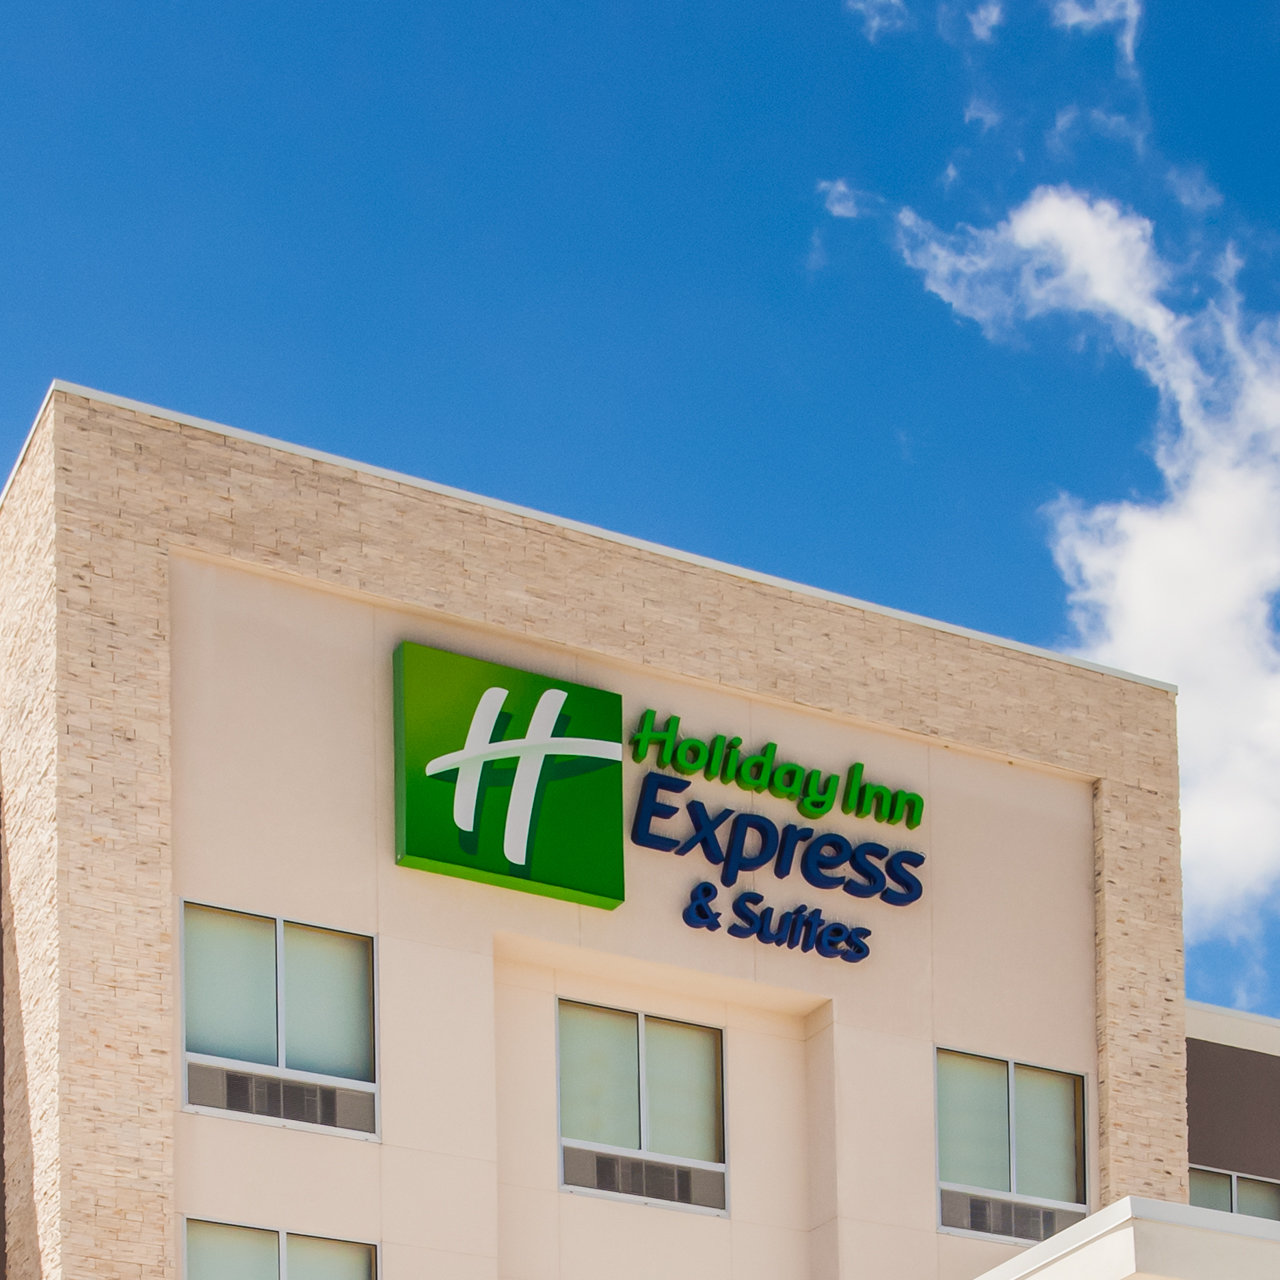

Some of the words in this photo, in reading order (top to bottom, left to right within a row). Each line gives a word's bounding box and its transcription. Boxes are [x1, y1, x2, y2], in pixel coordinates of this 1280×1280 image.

[628, 709, 840, 820] Holiday
[841, 762, 924, 830] Inn
[631, 771, 926, 906] Express
[682, 881, 722, 932] &
[727, 892, 872, 963] Suites
